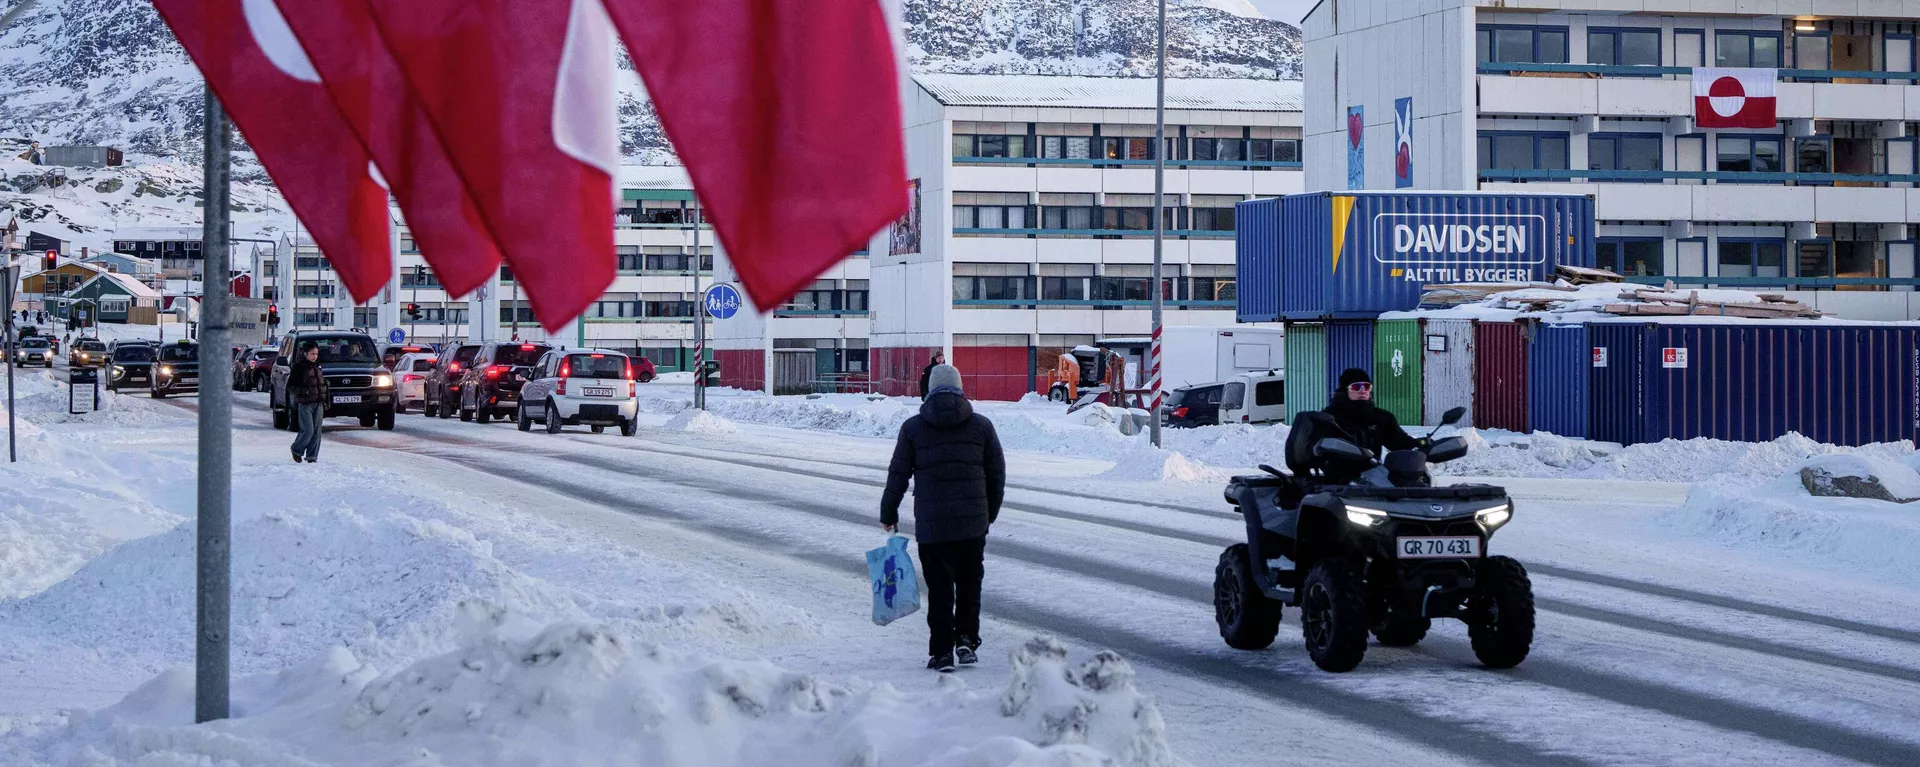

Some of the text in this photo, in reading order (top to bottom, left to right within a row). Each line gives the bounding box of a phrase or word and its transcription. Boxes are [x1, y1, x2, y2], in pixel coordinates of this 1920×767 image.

[1394, 224, 1526, 254] DAVIDSEN
[1404, 268, 1532, 283] ALT TIL BYGGERI
[235, 322, 256, 330] WATER
[1404, 540, 1472, 555] GR 70 431
